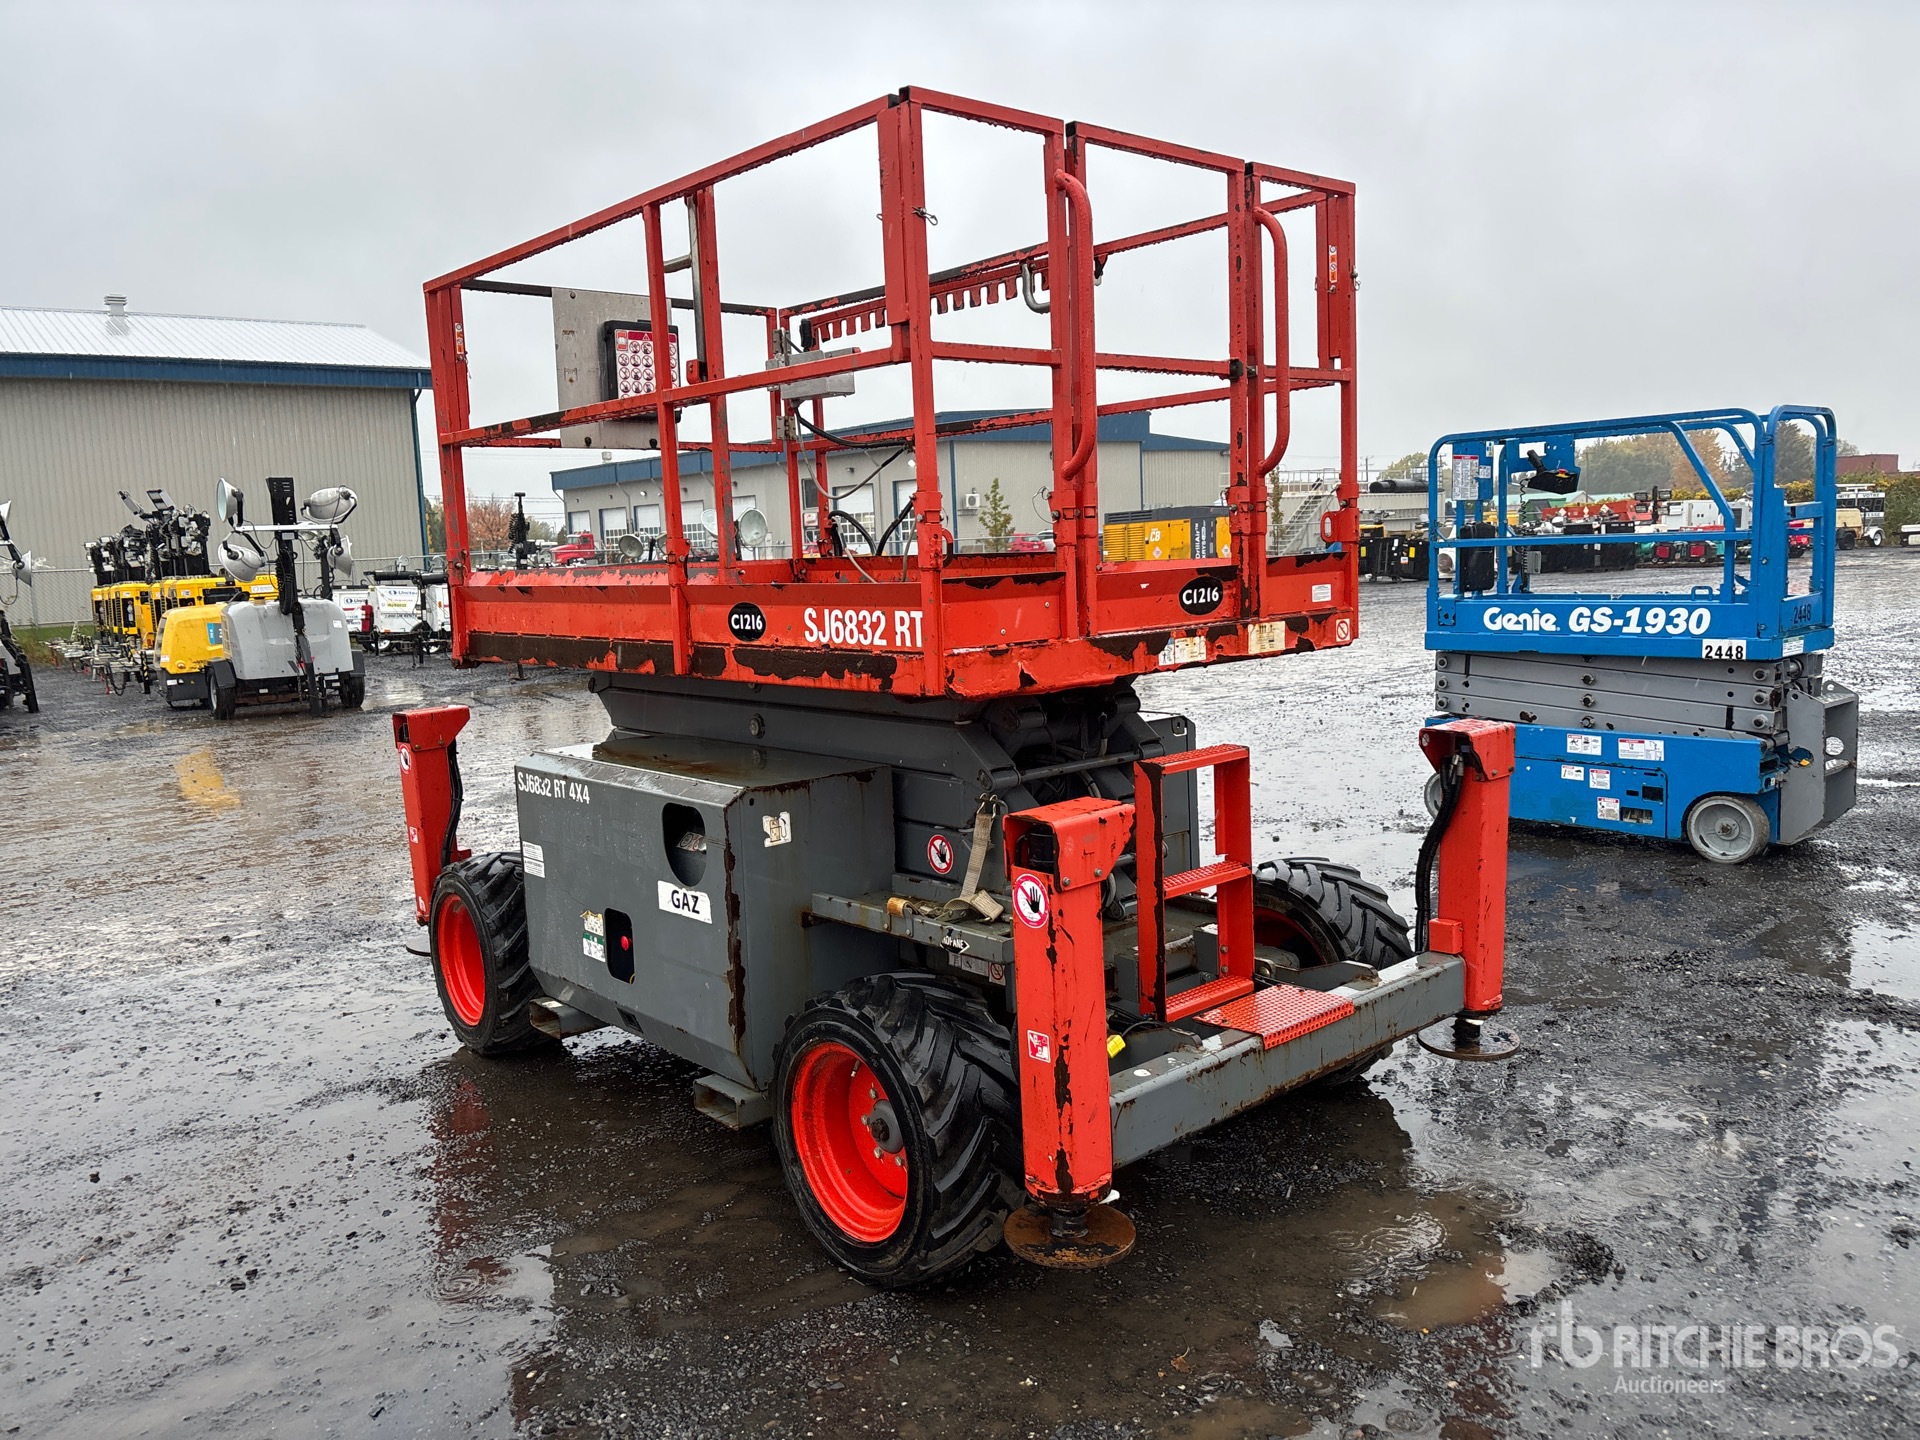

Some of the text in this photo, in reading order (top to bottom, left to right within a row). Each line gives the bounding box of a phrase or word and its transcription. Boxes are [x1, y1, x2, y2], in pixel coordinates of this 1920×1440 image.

[1182, 587, 1220, 605] C1216
[731, 613, 763, 631] C1216
[1568, 606, 1711, 635] GS-1930
[1793, 603, 1812, 624] 2448
[803, 607, 923, 648] SJ6832 RT
[1704, 644, 1744, 660] 2448
[517, 771, 591, 805] SJ6832 RT 4X4
[671, 889, 700, 915] GAZ
